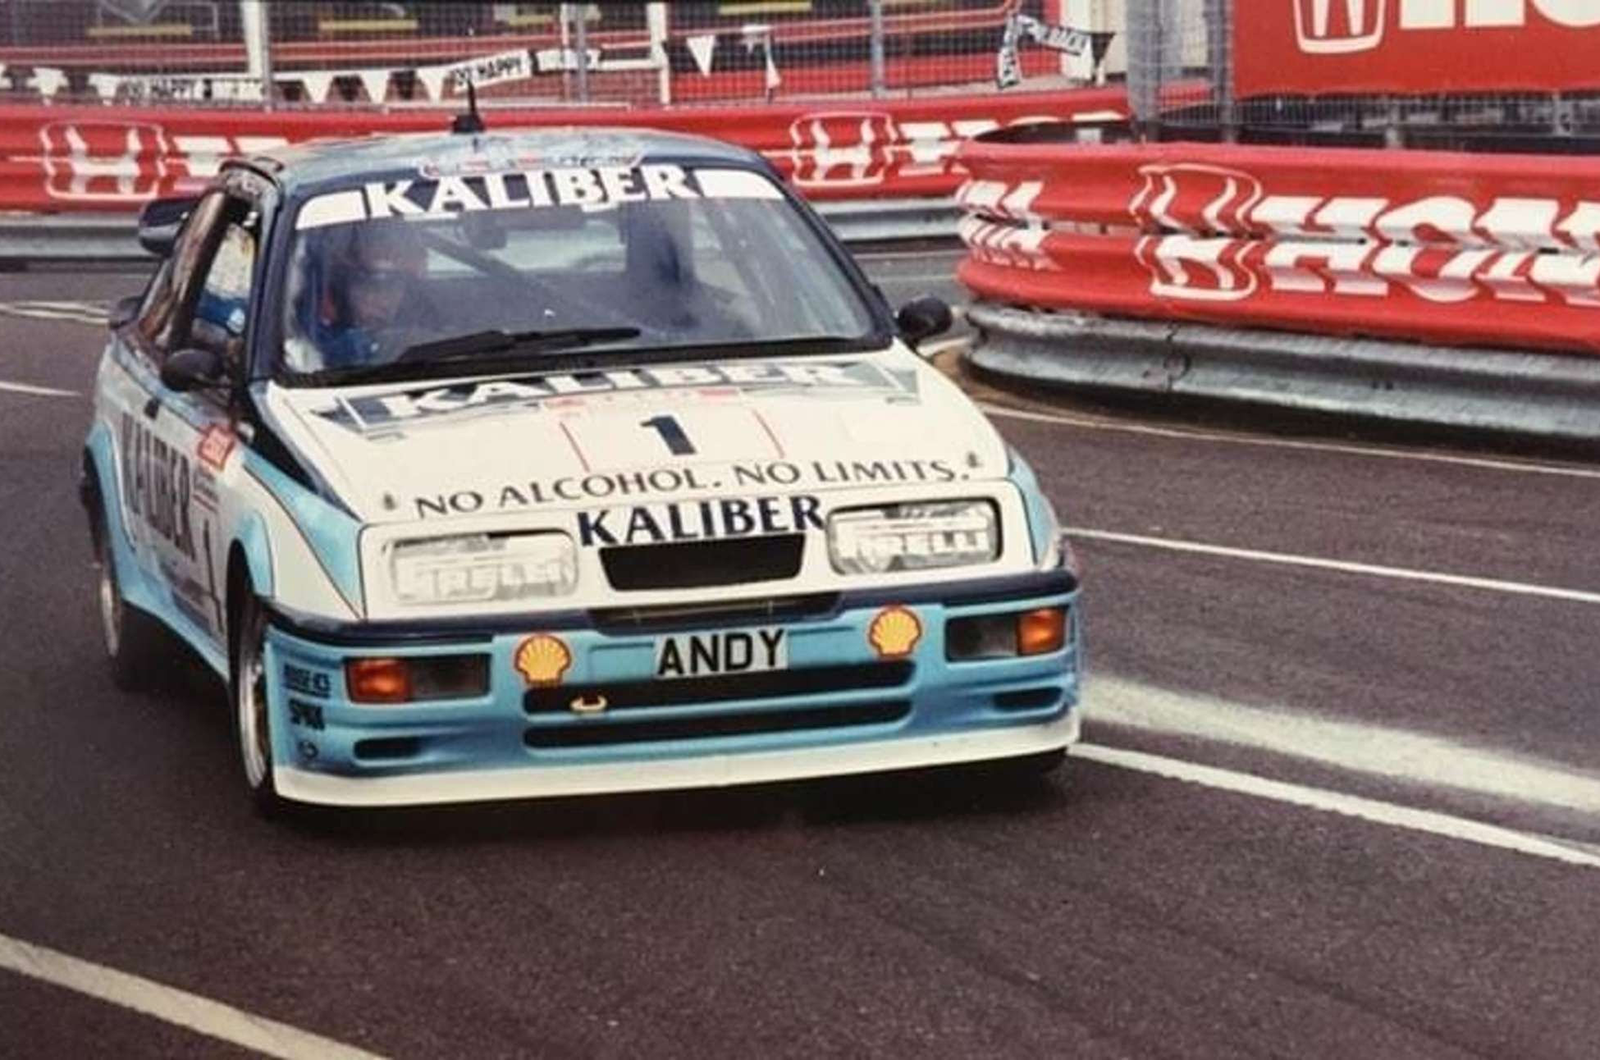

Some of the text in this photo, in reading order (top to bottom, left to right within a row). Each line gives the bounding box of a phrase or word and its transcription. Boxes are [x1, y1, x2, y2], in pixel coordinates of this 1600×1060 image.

[365, 164, 700, 219] KALIBER
[380, 363, 866, 417] KALIBER
[639, 415, 697, 456] 1
[415, 460, 970, 519] NO ALCOHOL. NO LIMITS.
[576, 494, 826, 548] KALIBER
[657, 628, 785, 676] ANDY
